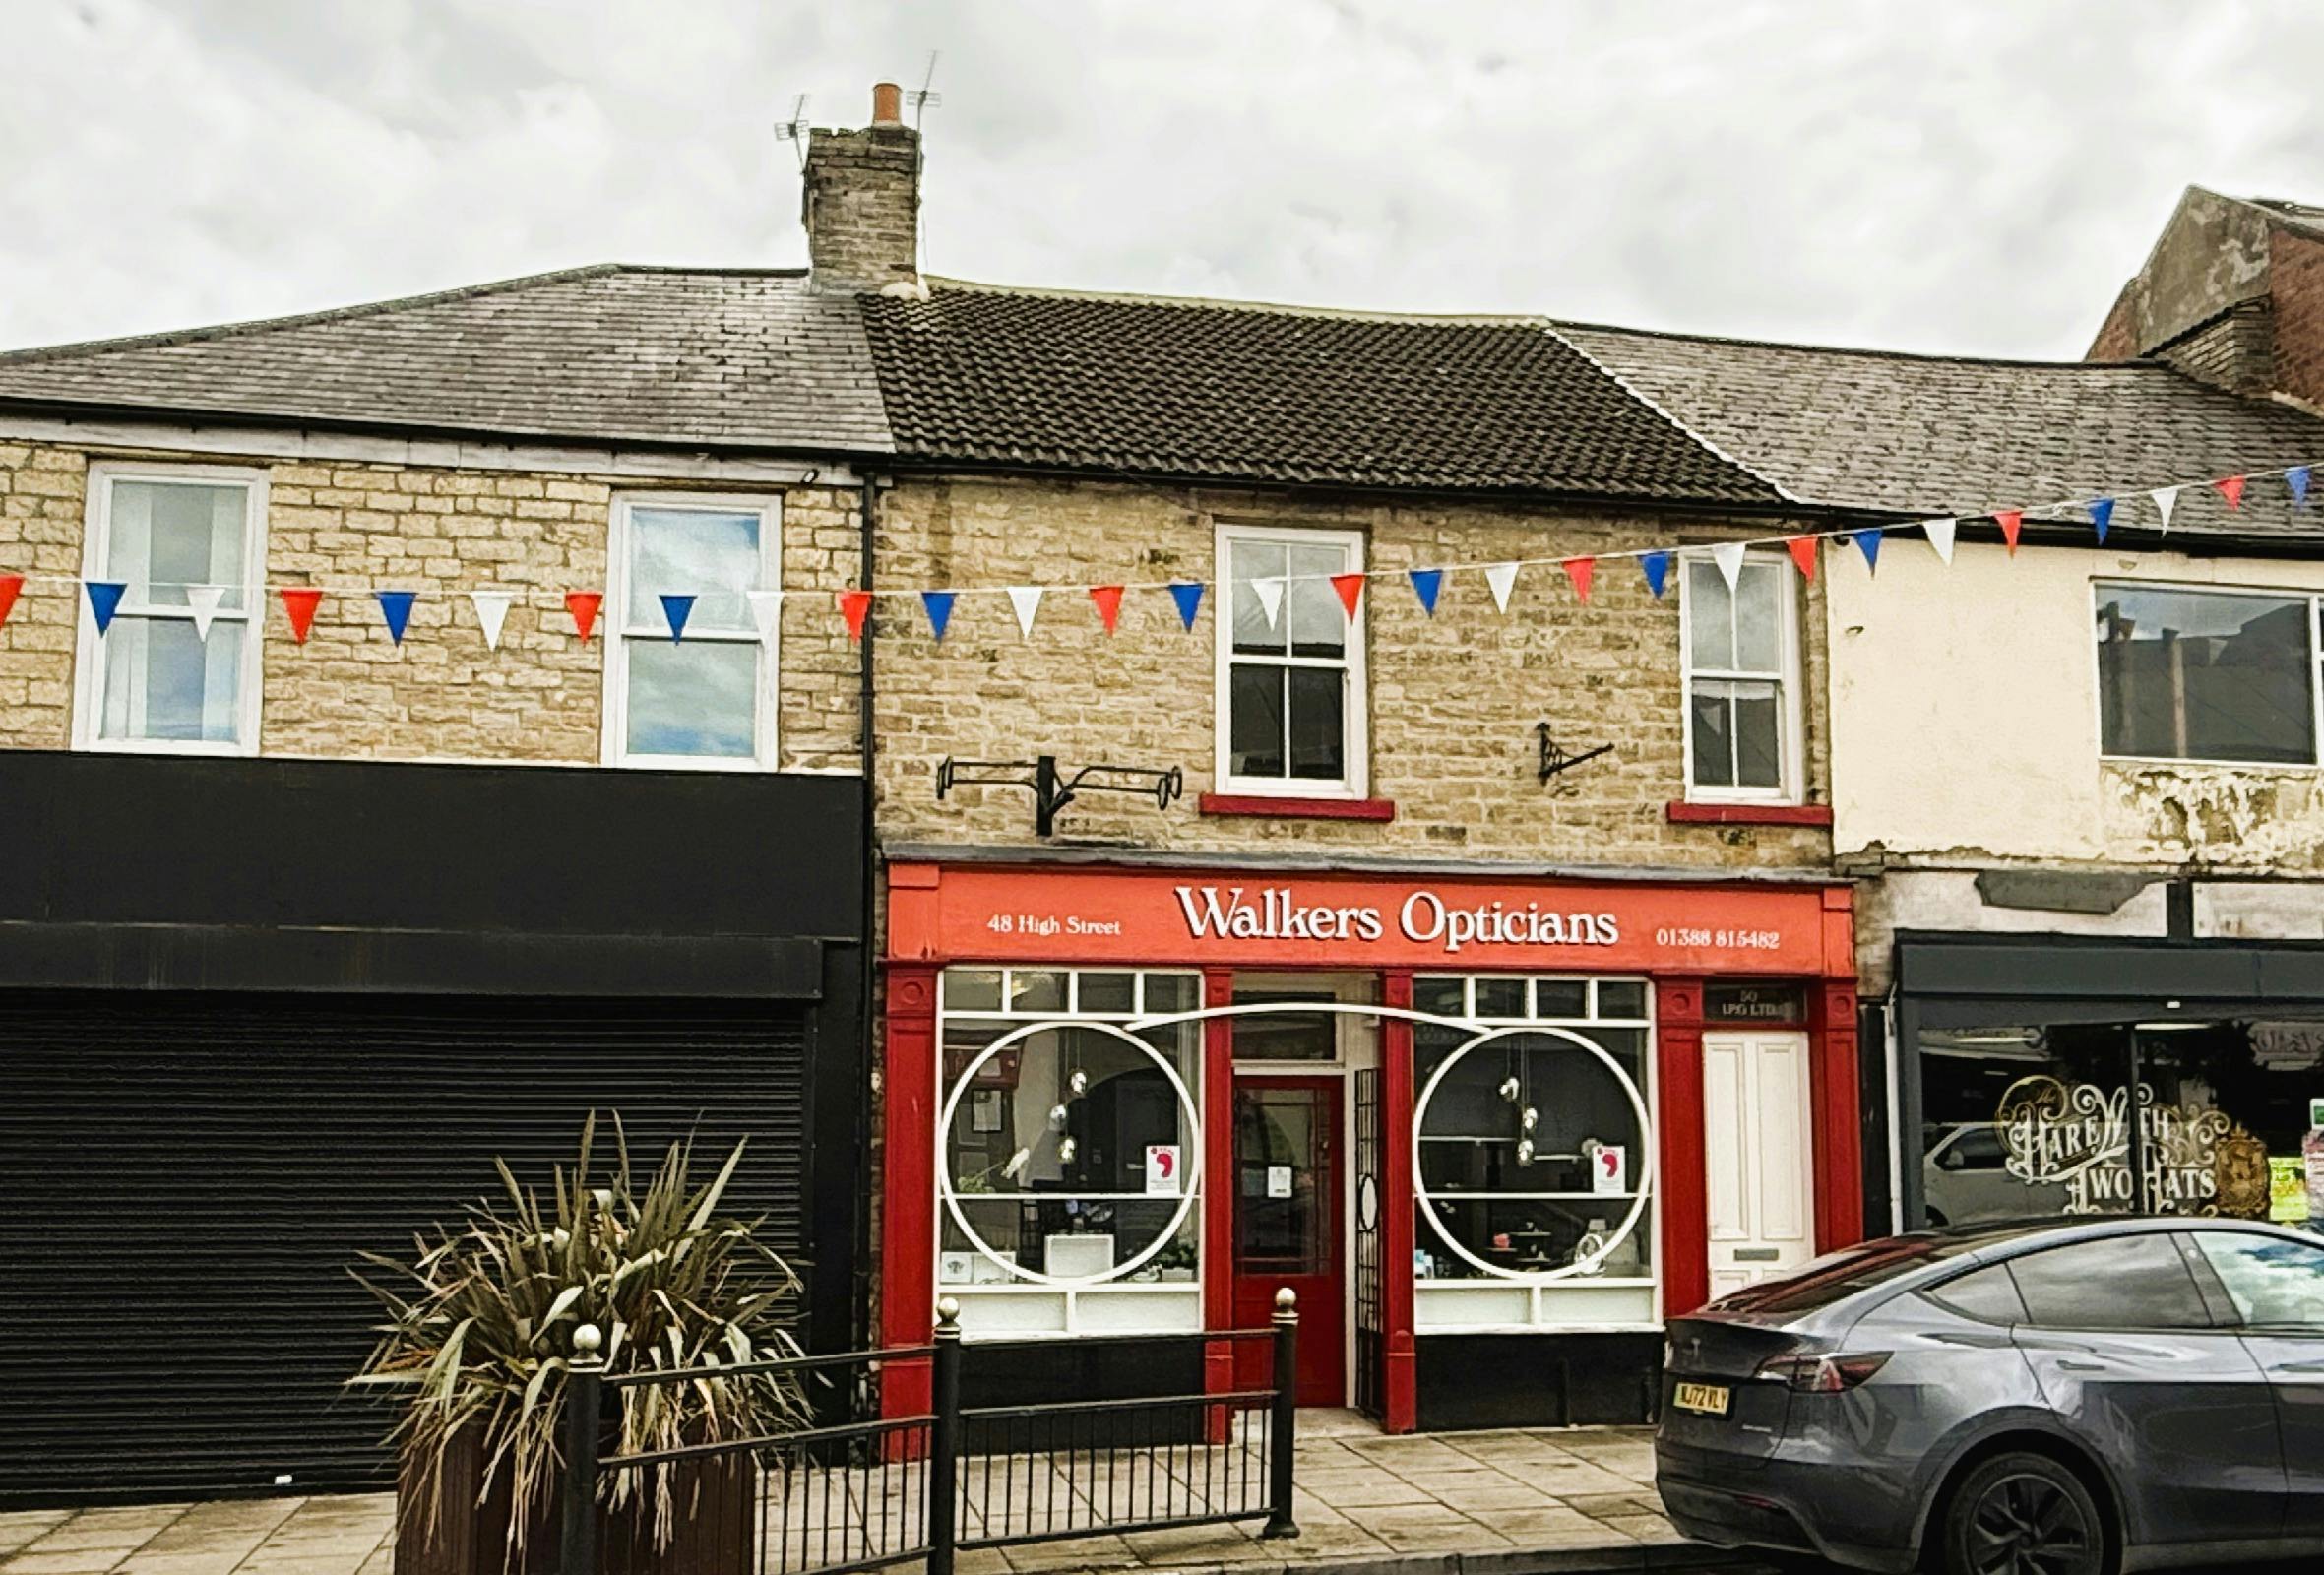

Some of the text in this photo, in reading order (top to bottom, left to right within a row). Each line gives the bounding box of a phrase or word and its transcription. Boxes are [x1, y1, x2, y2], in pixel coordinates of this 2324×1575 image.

[986, 914, 1122, 936] 48 High Street
[1174, 886, 1619, 951] Walkers Opticians
[1656, 928, 1781, 950] 01388 815482
[2072, 1083, 2168, 1154] WTH
